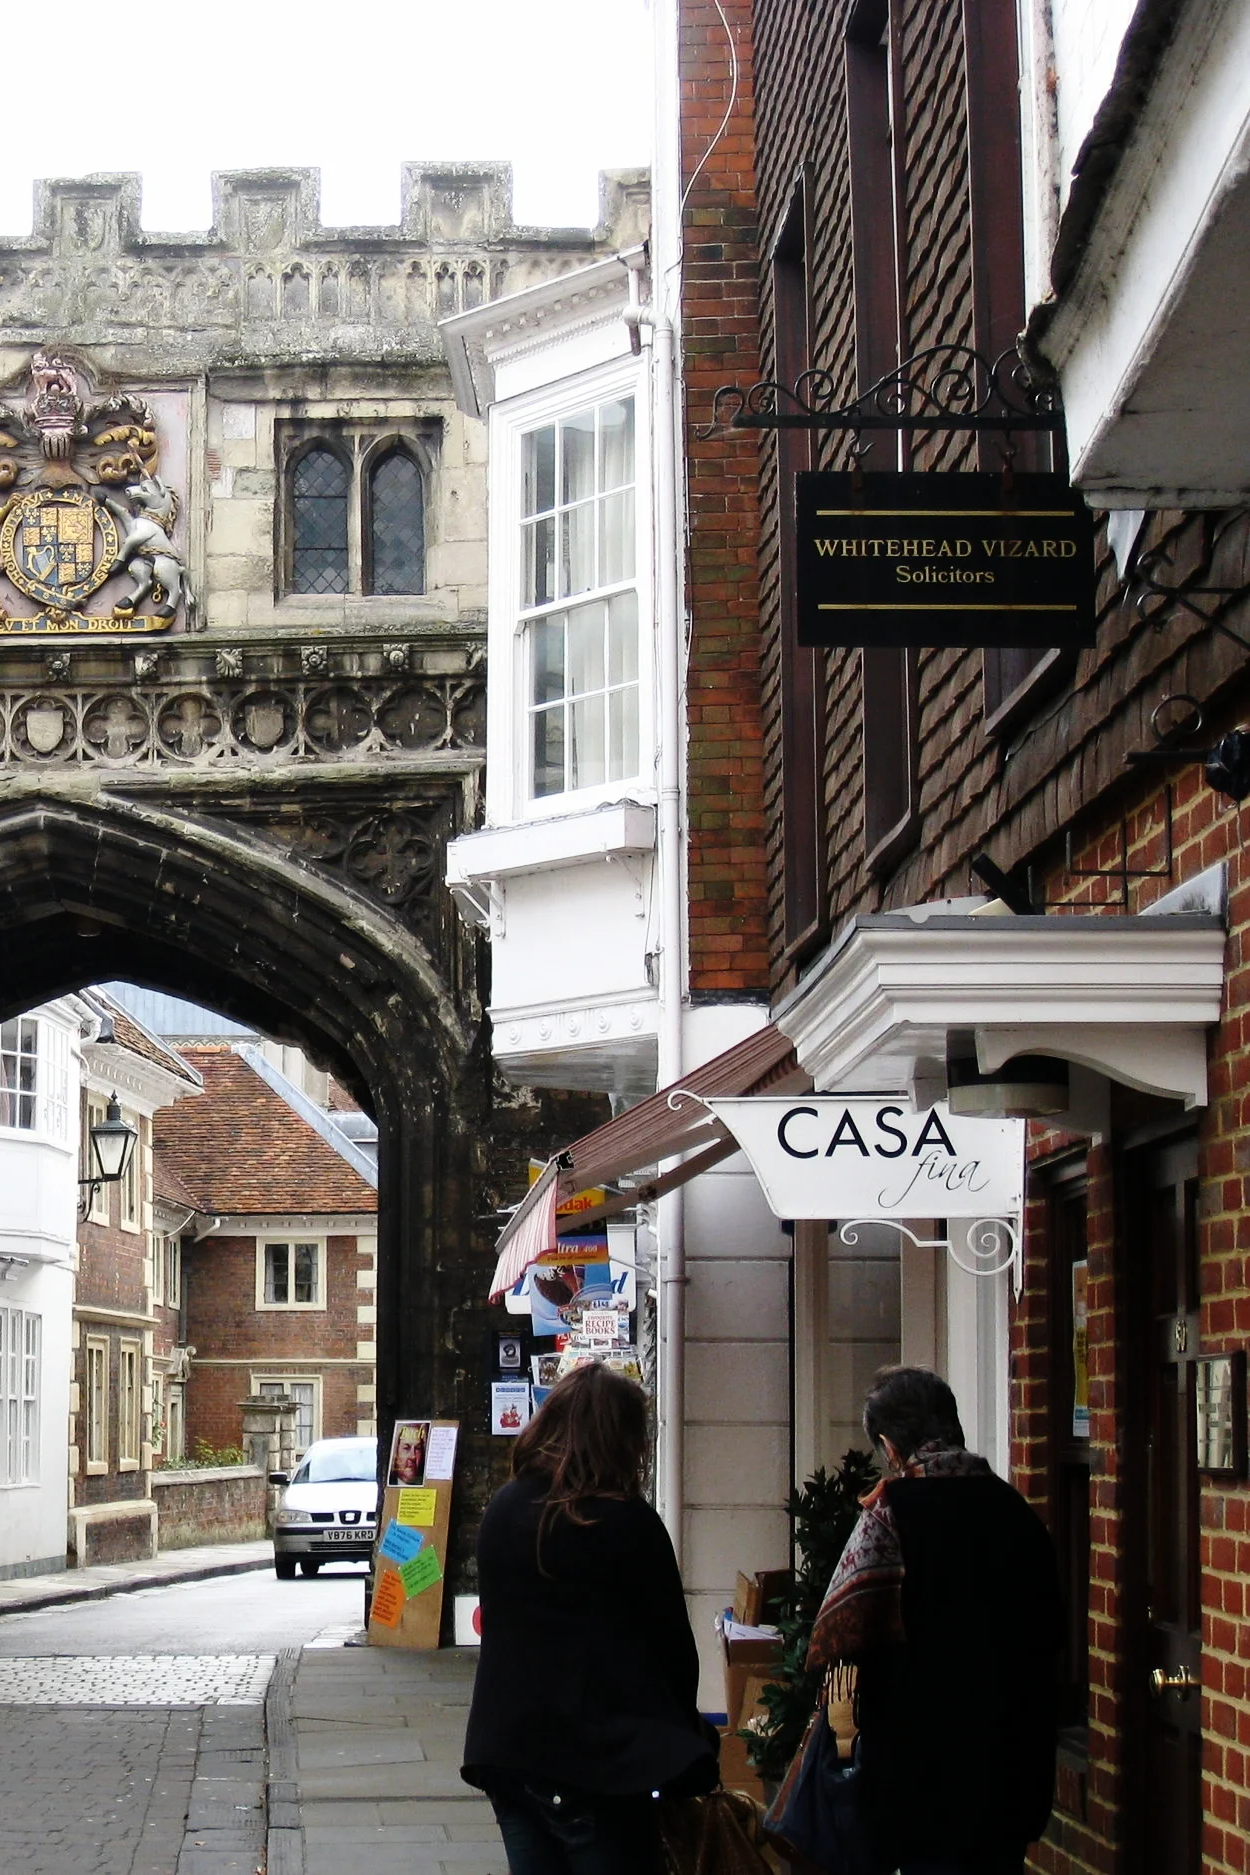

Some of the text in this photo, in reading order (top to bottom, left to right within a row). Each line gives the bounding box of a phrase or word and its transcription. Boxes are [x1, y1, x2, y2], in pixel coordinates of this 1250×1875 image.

[814, 539, 1077, 558] WHITEHEAD VIZARD
[896, 565, 995, 583] Solicitors
[22, 621, 39, 630] ET
[47, 619, 78, 631] MON
[89, 619, 134, 630] DROIT
[777, 1106, 957, 1159] CASA
[878, 1150, 990, 1208] fina
[585, 1320, 616, 1328] RECIPE
